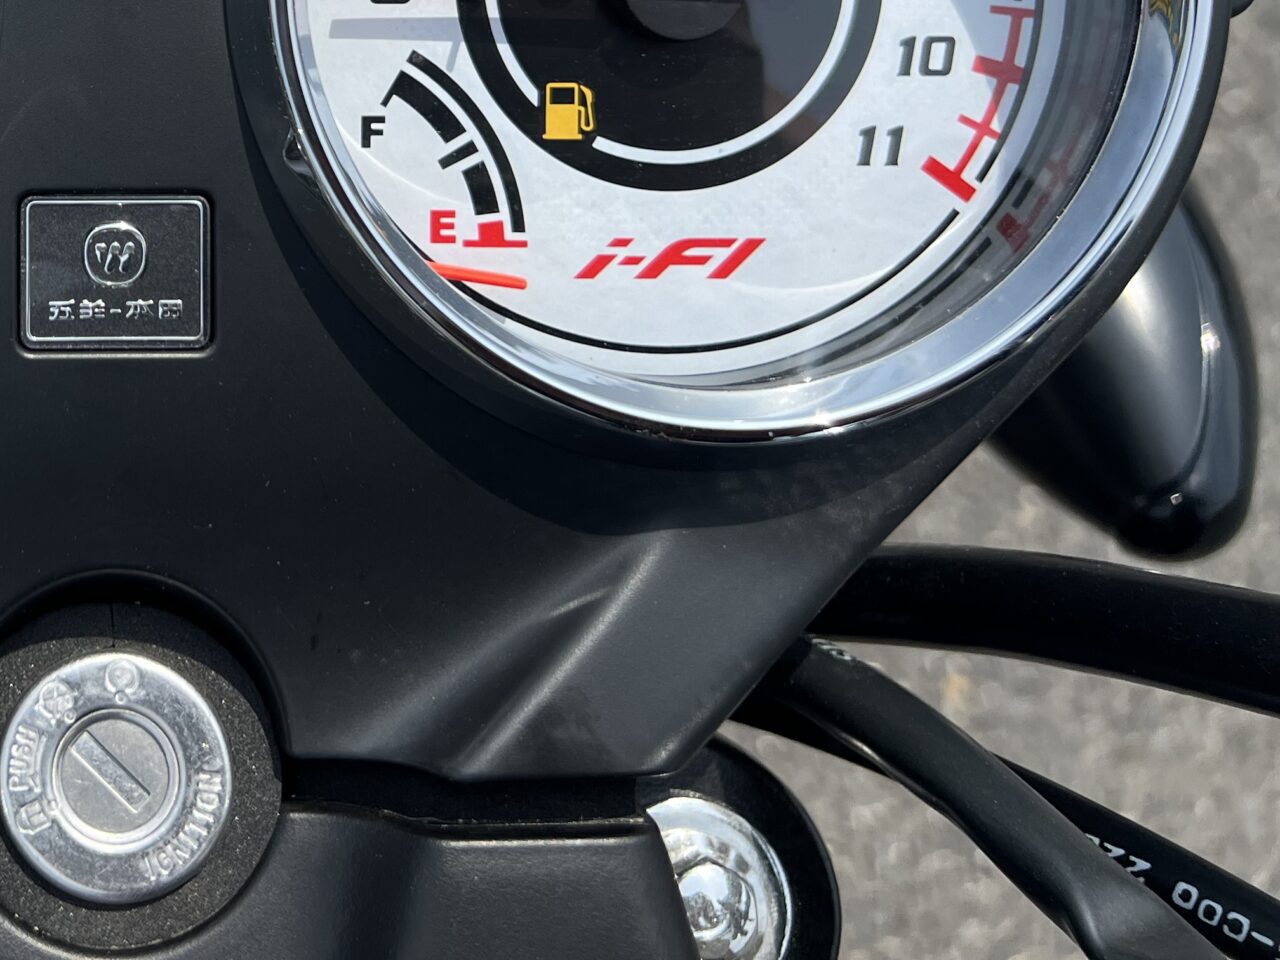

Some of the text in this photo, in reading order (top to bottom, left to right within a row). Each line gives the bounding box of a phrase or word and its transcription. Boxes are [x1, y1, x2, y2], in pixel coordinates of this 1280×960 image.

[896, 36, 956, 77] 10
[360, 115, 386, 148] F
[856, 125, 904, 167] 11
[429, 210, 457, 243] E
[8, 724, 40, 793] PUSH
[143, 772, 222, 881] IGNITION
